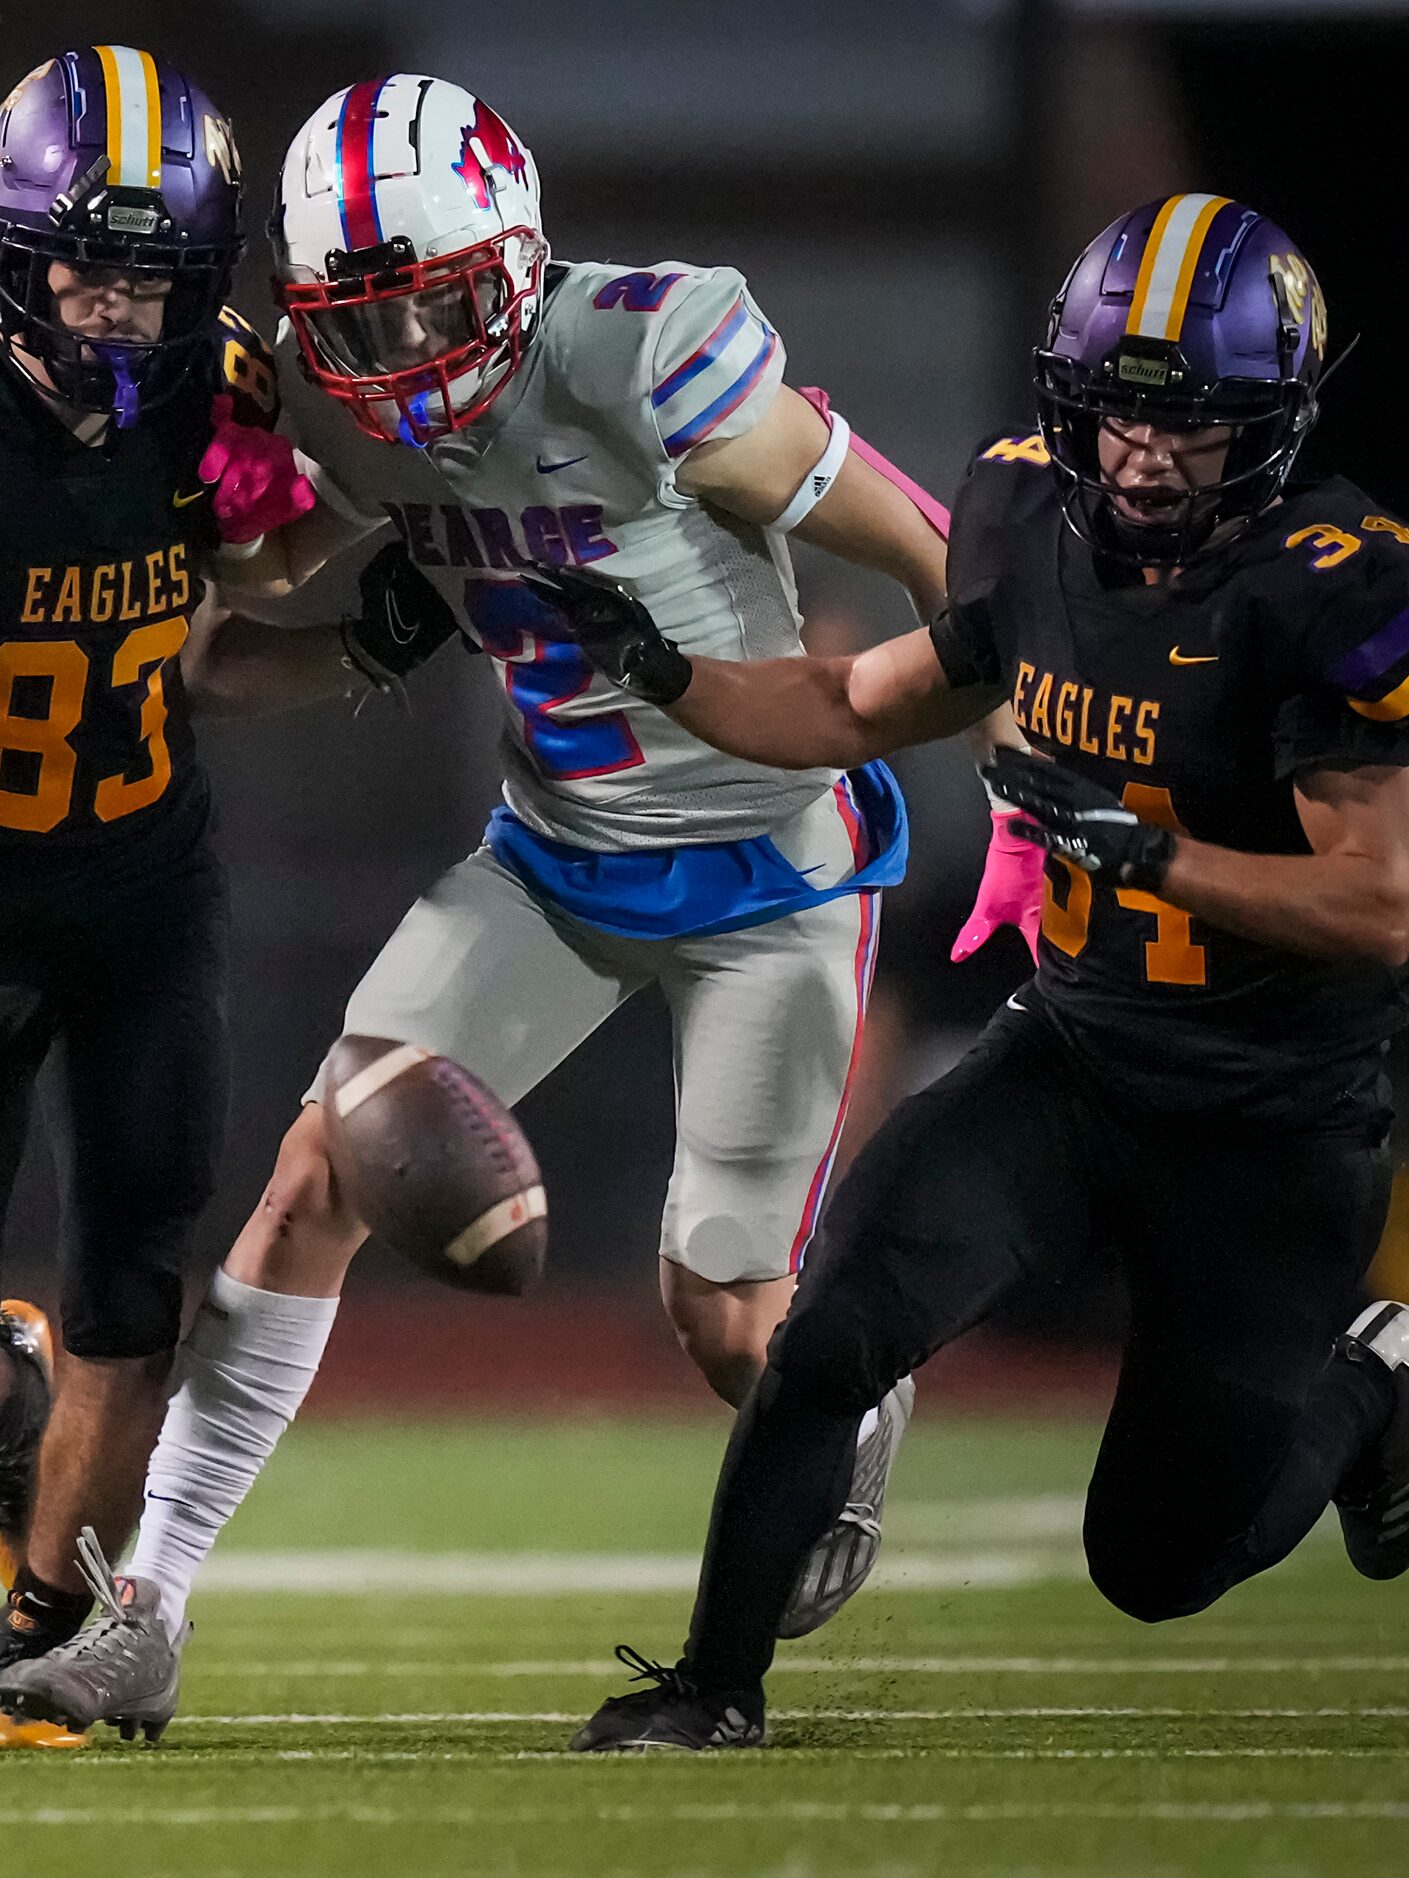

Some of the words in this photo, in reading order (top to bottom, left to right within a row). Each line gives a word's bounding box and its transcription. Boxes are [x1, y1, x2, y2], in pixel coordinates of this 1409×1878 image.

[593, 272, 689, 312] 2
[20, 543, 190, 623] EAGLES
[464, 579, 646, 781] 2
[1012, 660, 1160, 766] EAGLES
